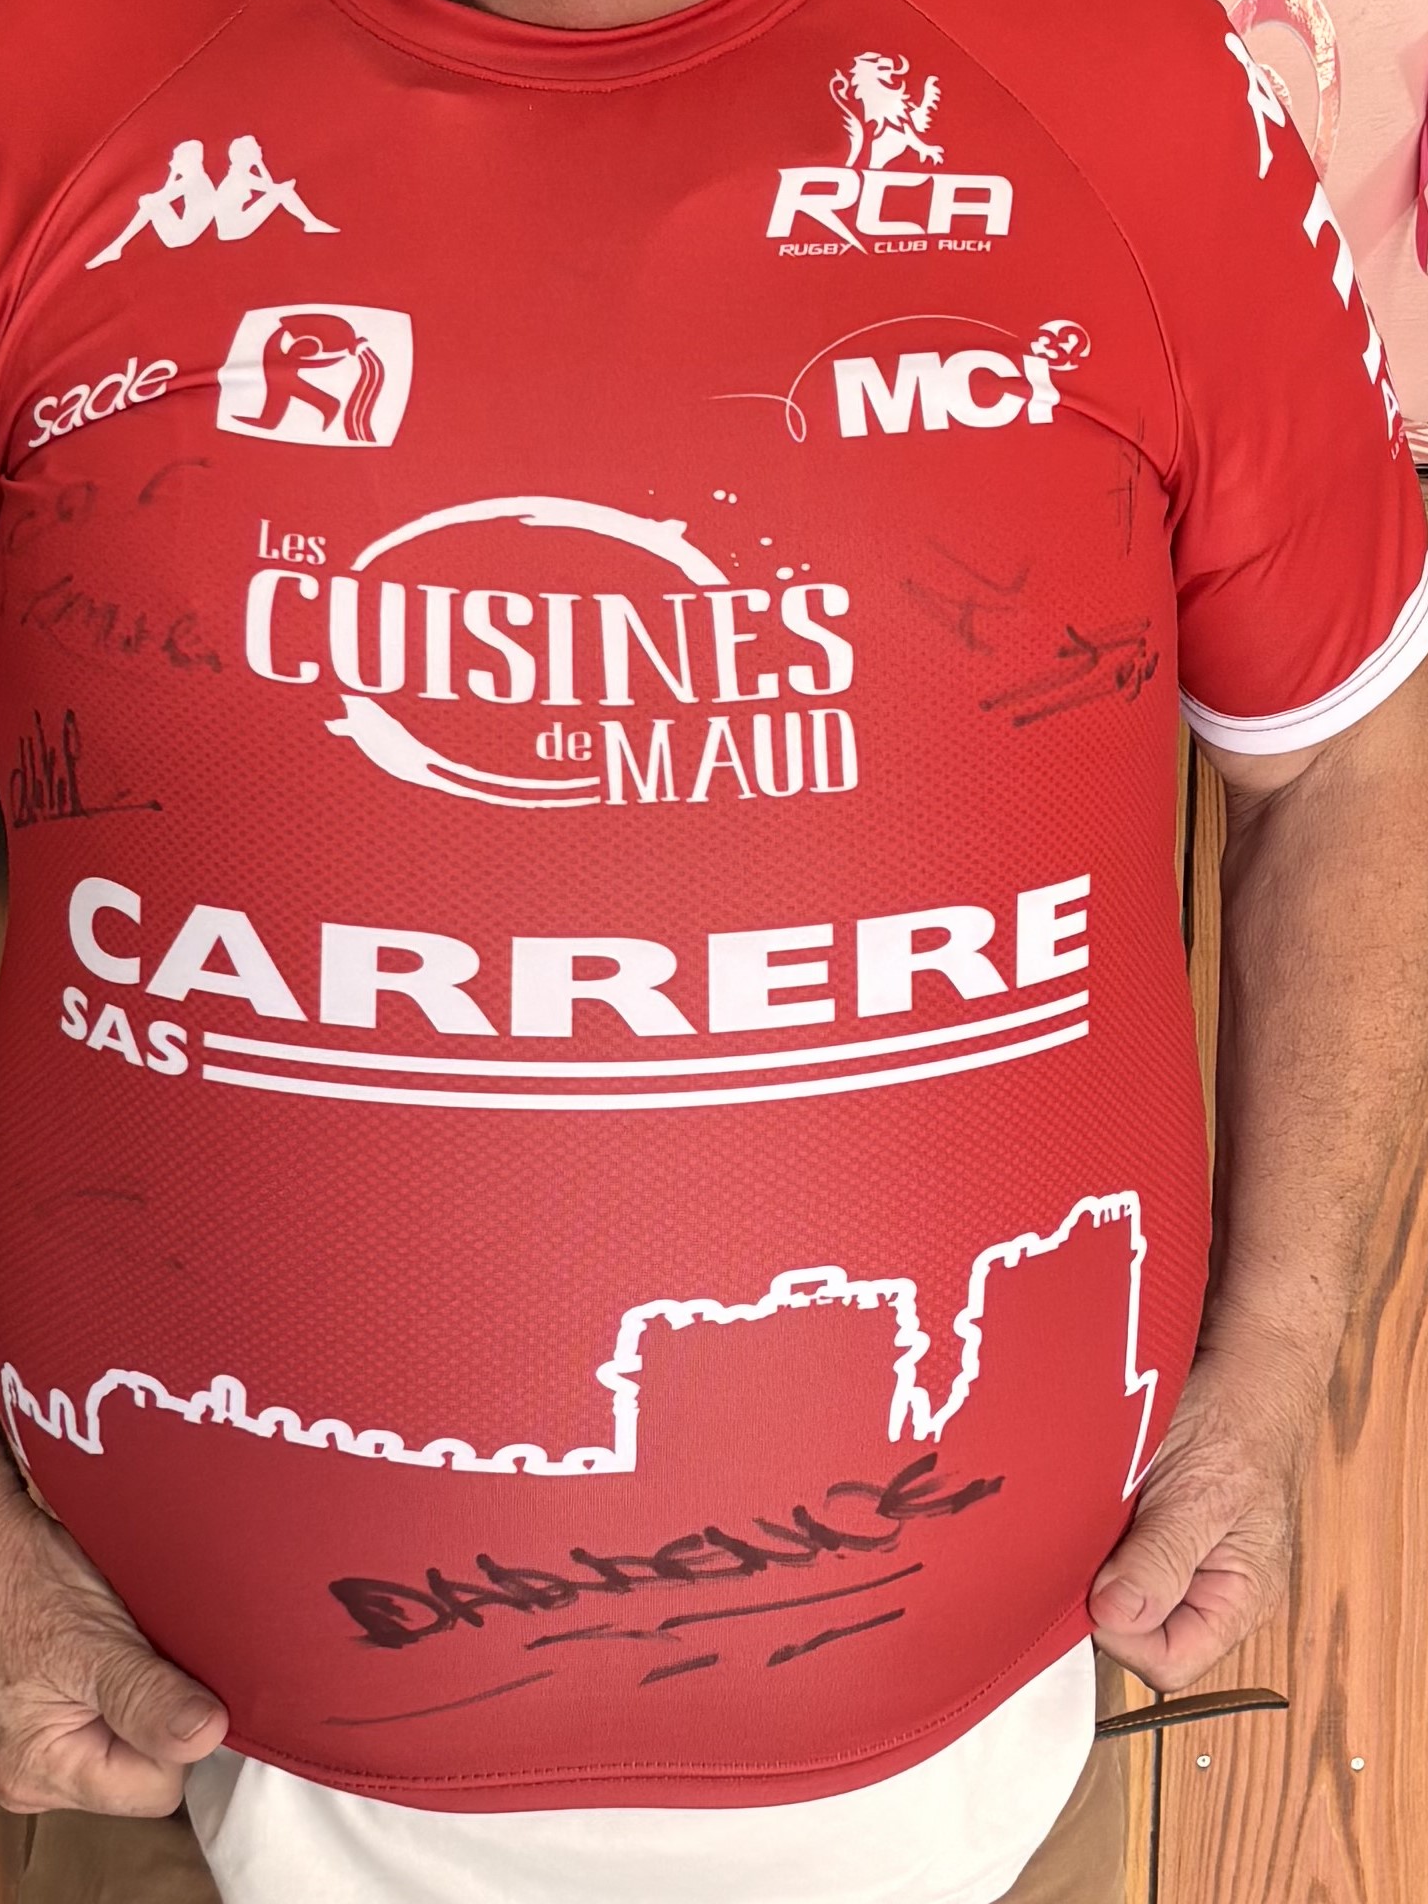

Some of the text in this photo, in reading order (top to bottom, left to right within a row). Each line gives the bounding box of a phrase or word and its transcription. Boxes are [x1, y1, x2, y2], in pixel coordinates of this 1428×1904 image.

[765, 165, 1014, 246] RCA
[778, 239, 992, 257] RUGBY CLUB AUCH
[28, 356, 178, 449] sade
[833, 349, 1062, 438] MCI
[257, 518, 327, 566] Les
[245, 568, 855, 707] CUISINES
[535, 708, 858, 805] de MAUD
[66, 873, 1091, 1038] CARRERE
[60, 985, 190, 1076] SAS
